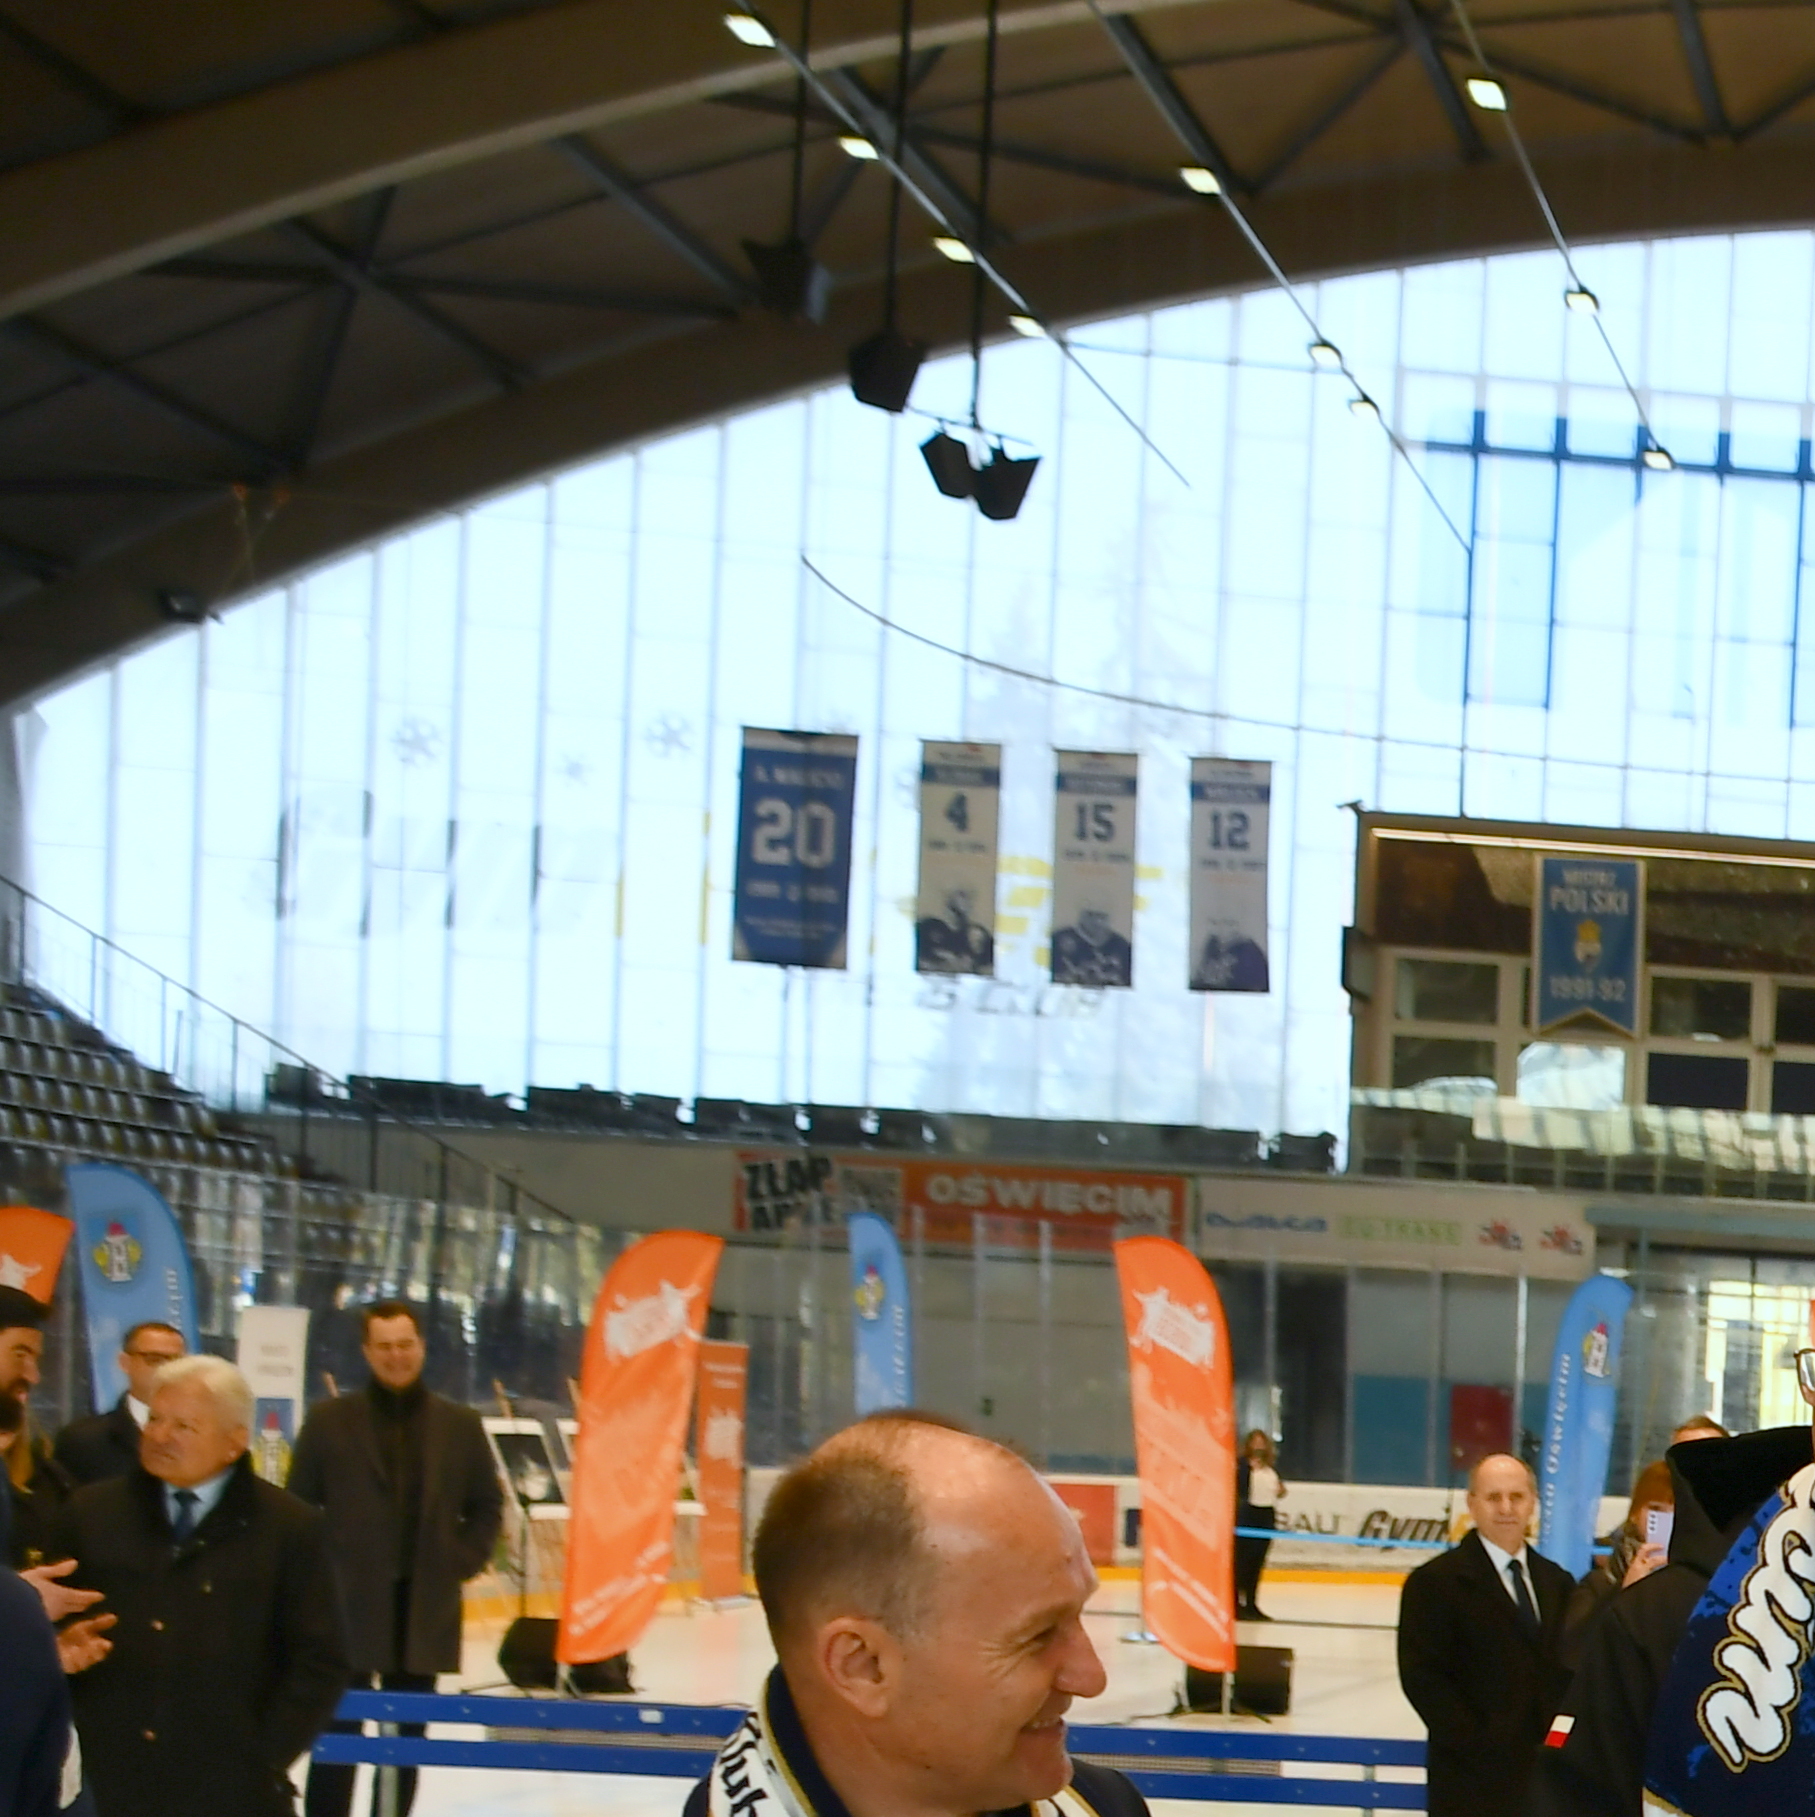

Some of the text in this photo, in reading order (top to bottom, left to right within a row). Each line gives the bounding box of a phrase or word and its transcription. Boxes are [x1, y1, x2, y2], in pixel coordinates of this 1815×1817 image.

[944, 793, 969, 833] 4
[1073, 803, 1116, 844] 15
[1208, 810, 1250, 851] 12
[751, 799, 836, 868] 20
[1563, 869, 1616, 886] MISTRZ
[1550, 886, 1629, 914] POLSKI
